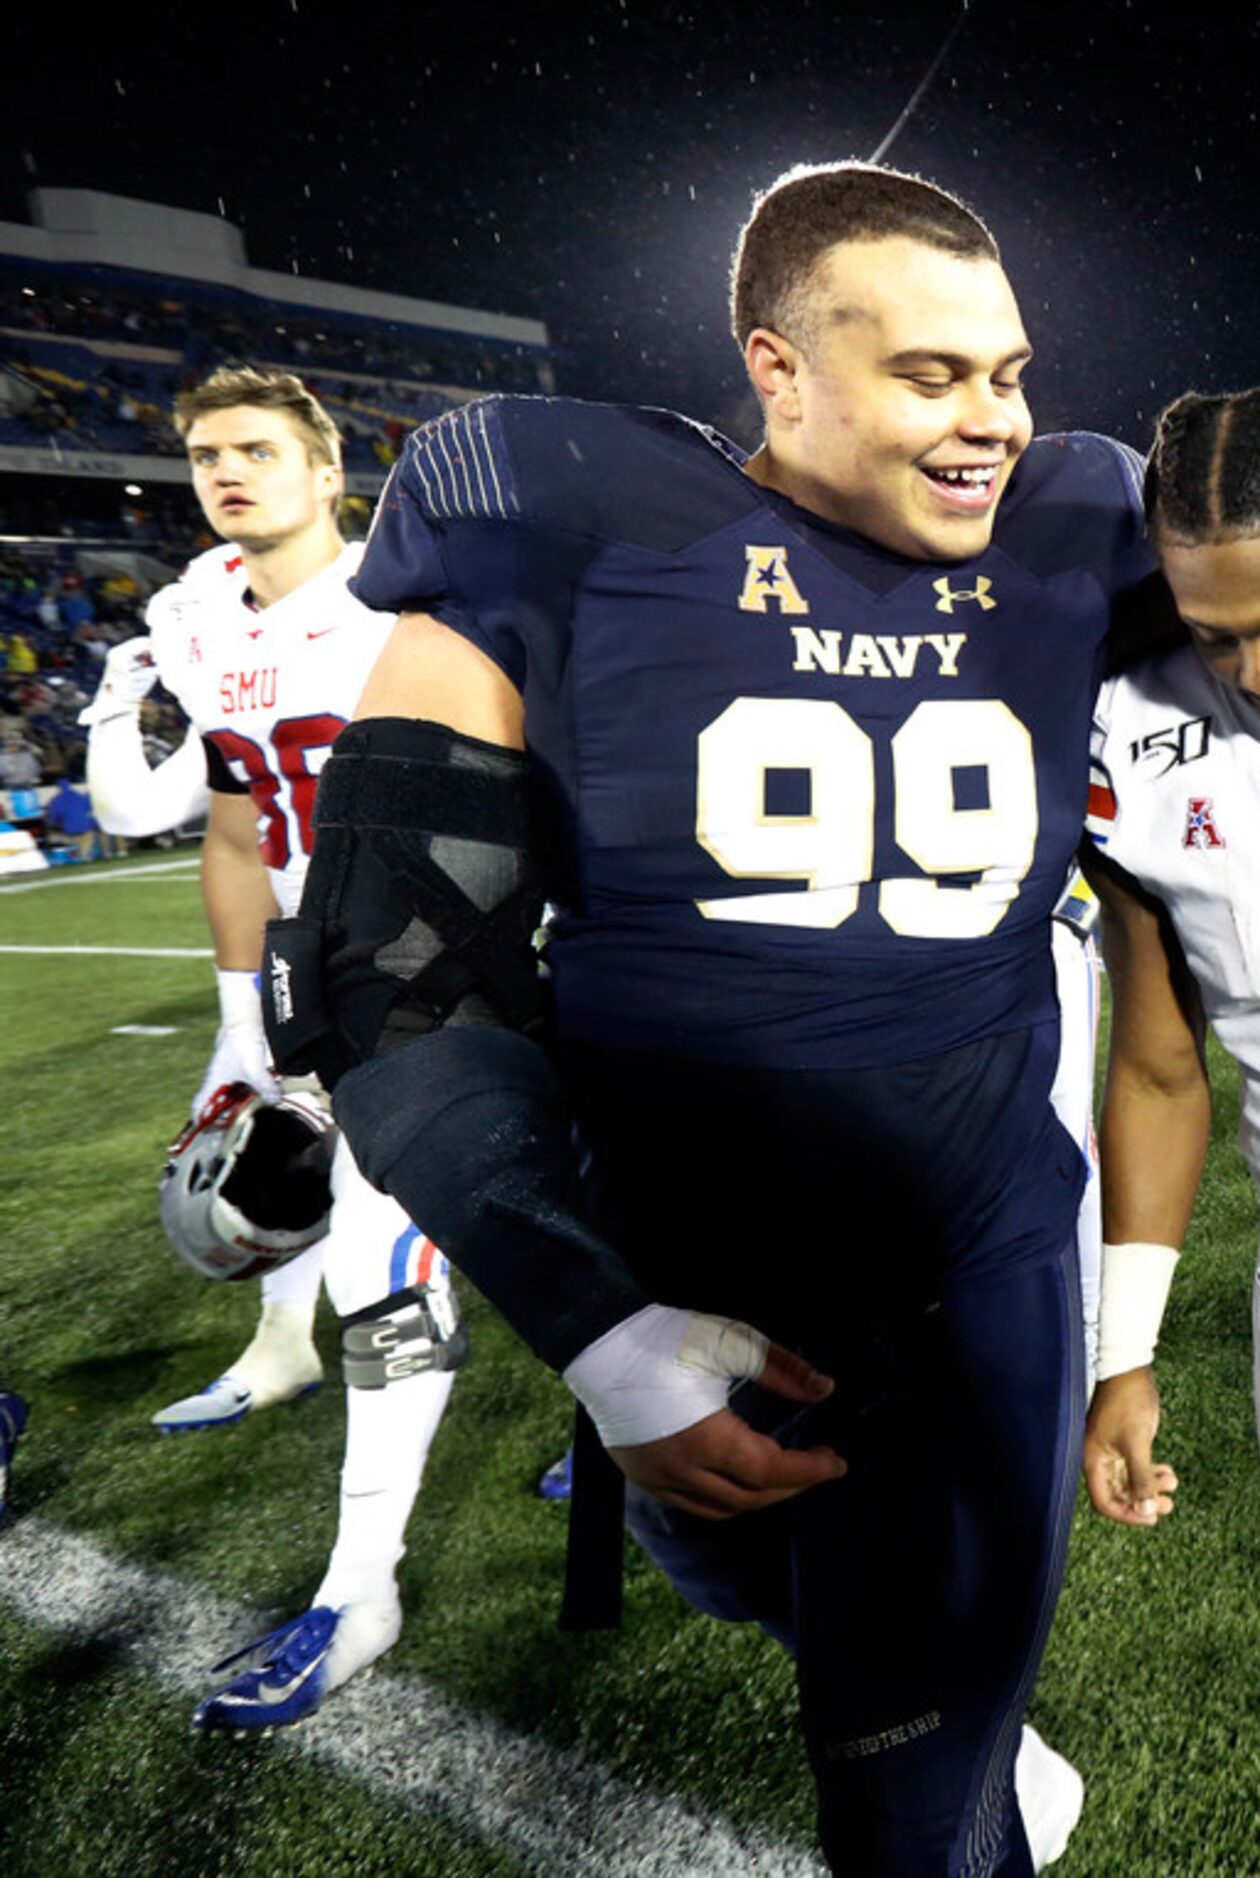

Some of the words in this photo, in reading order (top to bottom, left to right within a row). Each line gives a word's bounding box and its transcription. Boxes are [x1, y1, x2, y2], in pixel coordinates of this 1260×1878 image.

[790, 627, 966, 678] NAVY
[219, 667, 278, 713] SMU
[1129, 716, 1211, 779] 150
[694, 696, 1039, 939] 99
